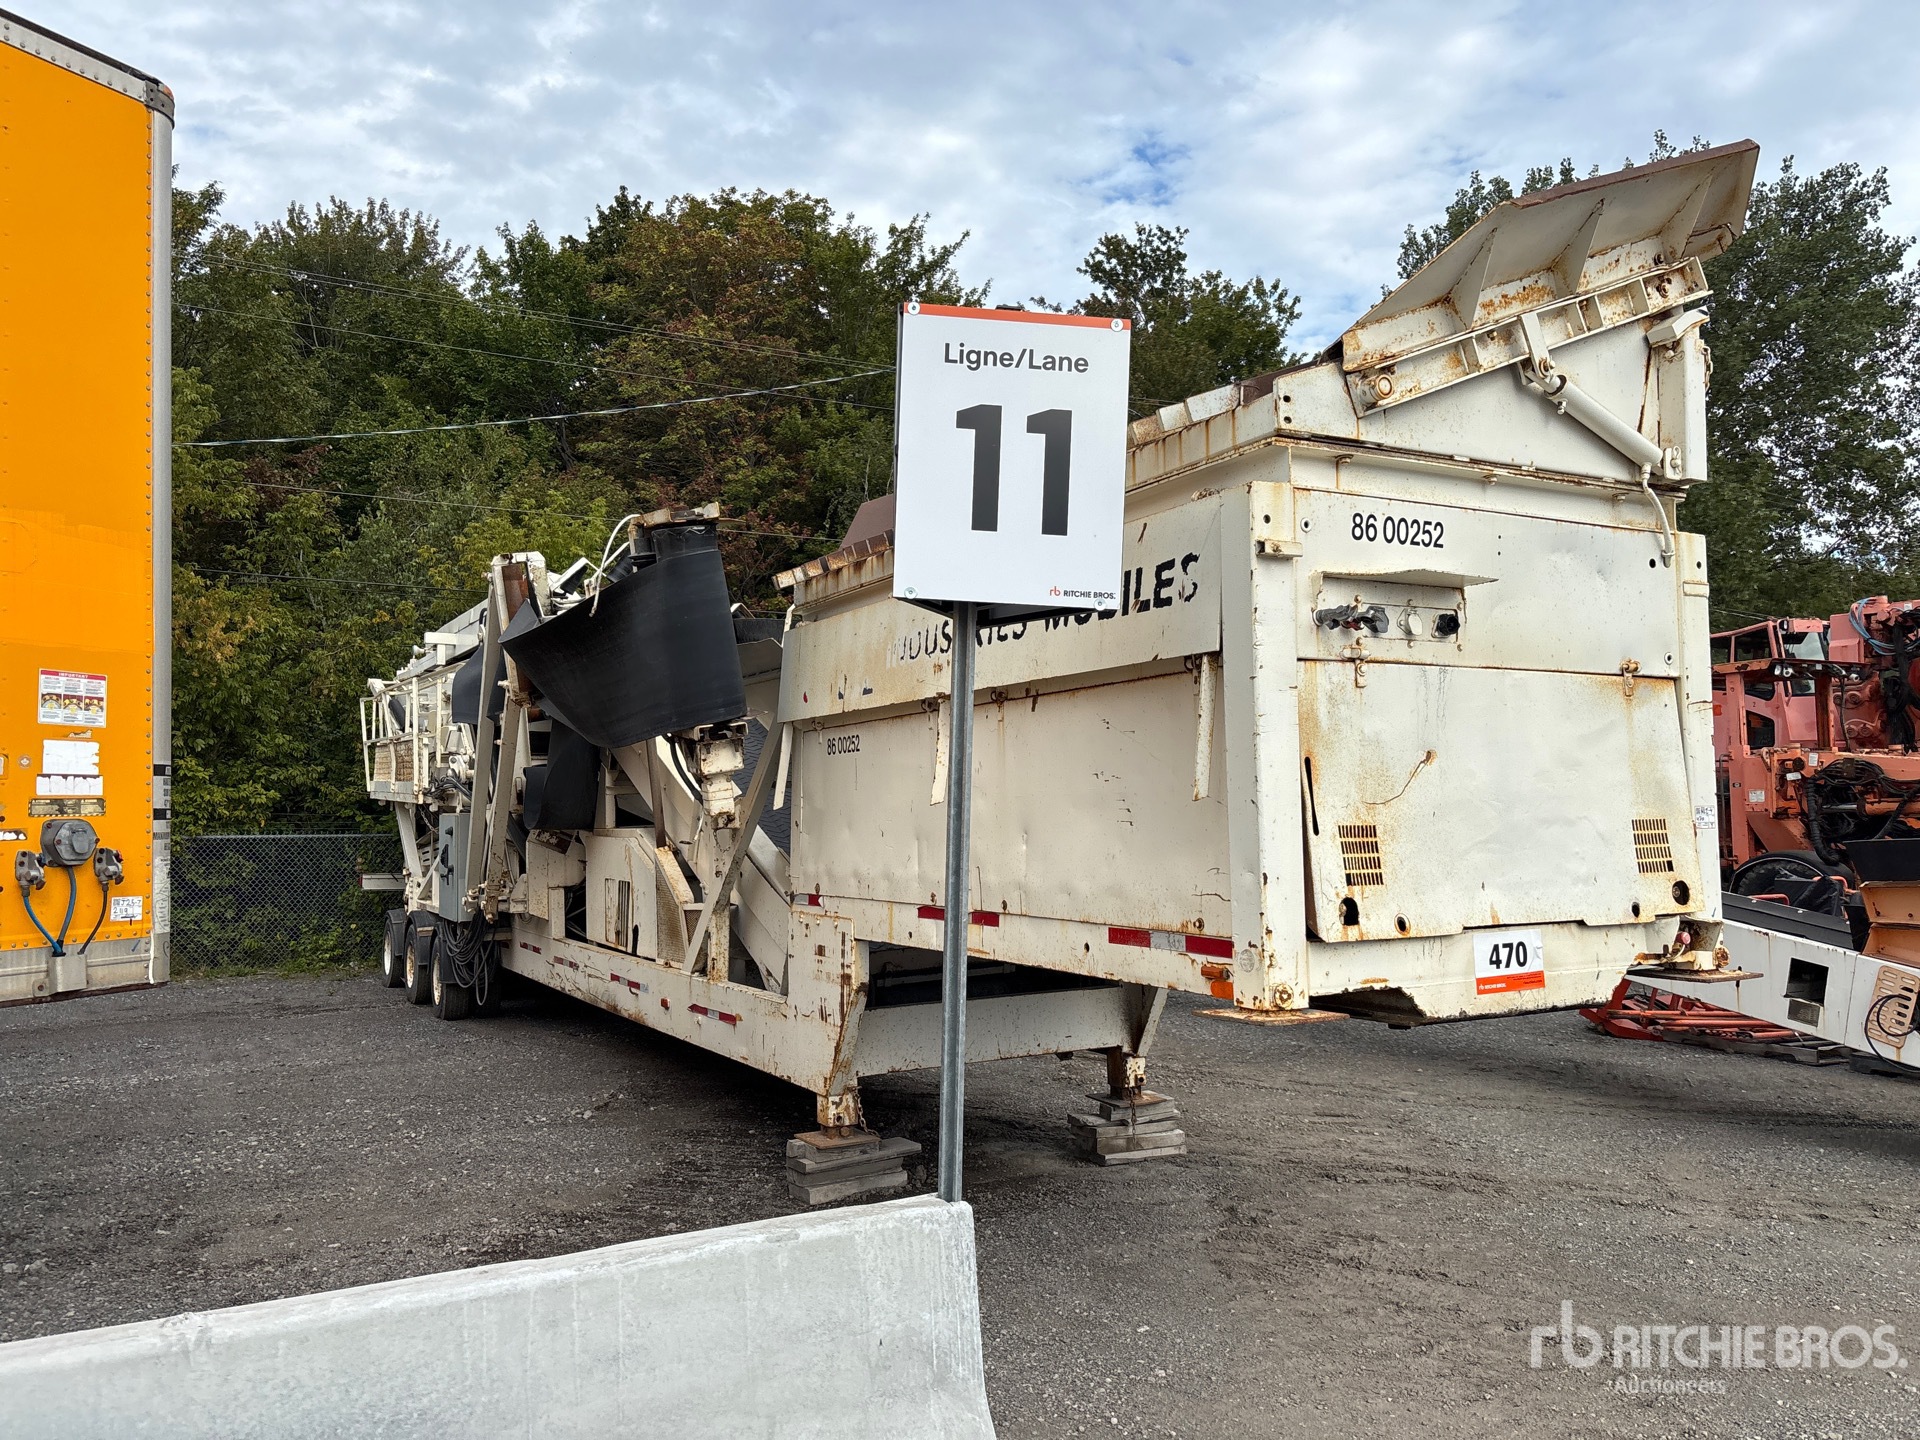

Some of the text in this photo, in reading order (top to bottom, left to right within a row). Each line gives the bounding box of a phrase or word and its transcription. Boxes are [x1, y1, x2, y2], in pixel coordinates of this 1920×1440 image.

[944, 342, 1089, 373] Ligne/Lane
[955, 403, 1073, 537] 11
[1351, 512, 1444, 549] 86 00252
[1063, 589, 1092, 599] RITCHIE
[827, 734, 861, 756] 86 00252
[1489, 941, 1528, 969] 470
